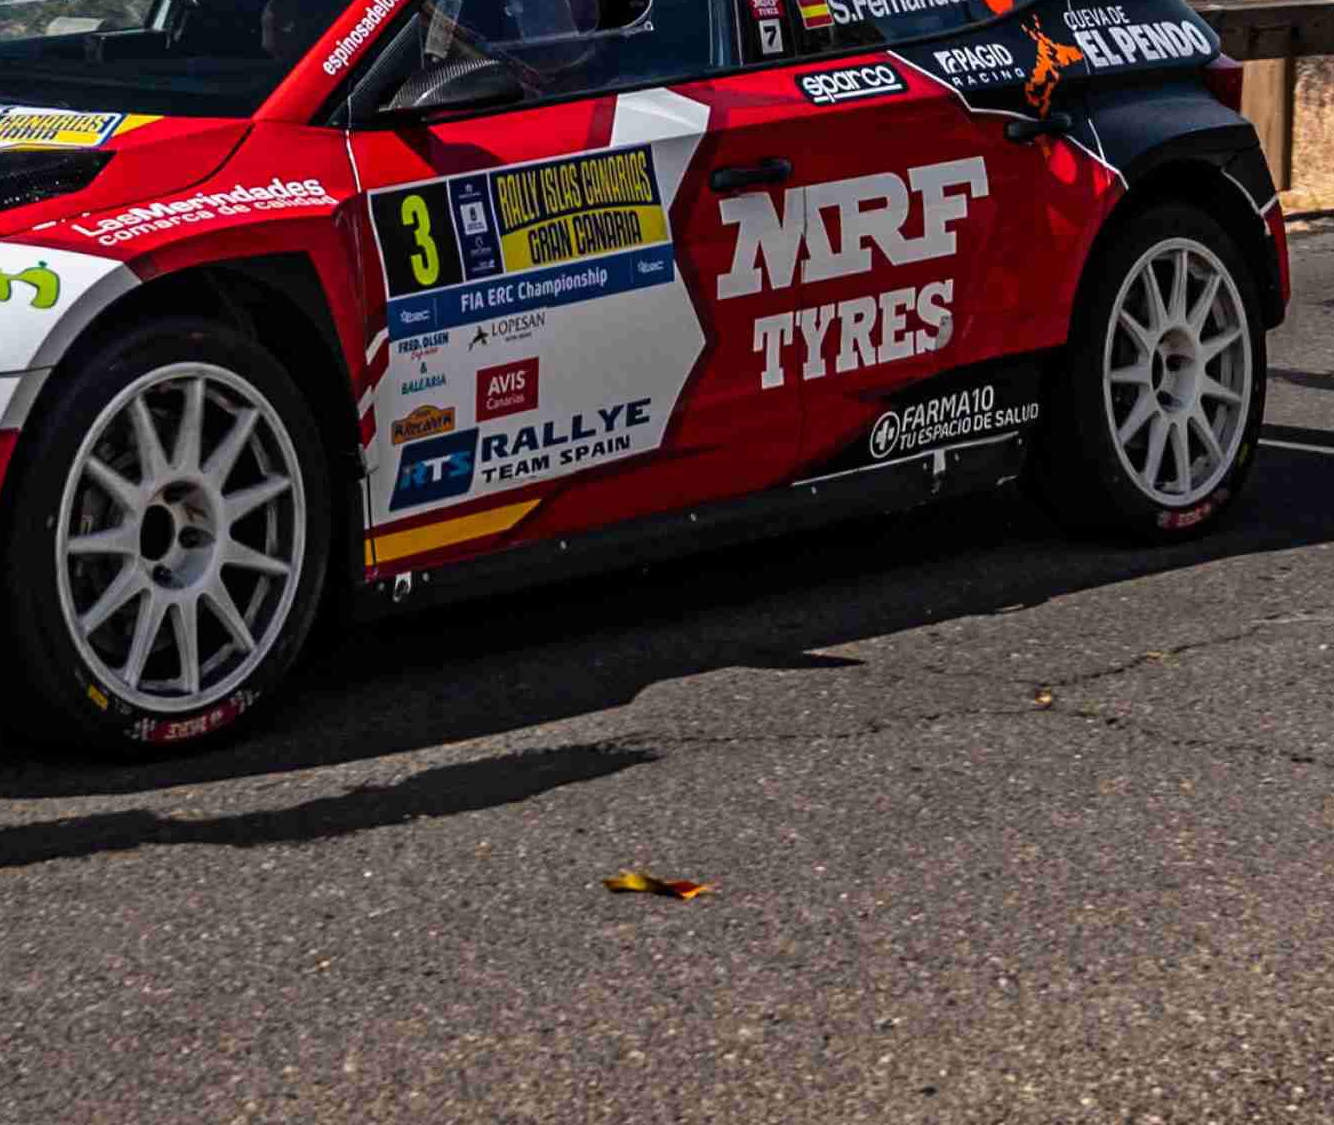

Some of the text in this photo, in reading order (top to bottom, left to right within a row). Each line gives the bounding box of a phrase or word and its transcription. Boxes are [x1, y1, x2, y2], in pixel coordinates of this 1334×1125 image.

[763, 25, 777, 46] 7
[1064, 4, 1131, 31] CUEVA DE
[955, 43, 1015, 74] PAGID
[1076, 19, 1212, 68] EL PENDO
[801, 62, 896, 103] sparco
[952, 66, 1025, 87] RACING
[496, 150, 653, 230] RALLY ISLAS CANARIAS
[98, 195, 339, 246] comarca de calidad
[401, 194, 440, 285] 3
[527, 209, 642, 265] GRAN CANARIA
[716, 156, 989, 300] MRF
[460, 293, 484, 313] FIA
[488, 286, 514, 305] ERC
[518, 266, 608, 300] Championship
[423, 332, 449, 348] OLSEN
[491, 312, 545, 336] LOPESAN
[753, 278, 955, 390] TYRES
[485, 394, 525, 411] Canarias
[487, 370, 526, 397] AVIS
[481, 398, 652, 463] RALLYE
[900, 402, 1039, 450] TU ESPACIO DE SALUD
[400, 450, 472, 490] RTS
[481, 435, 631, 484] TEAM SPAIN
